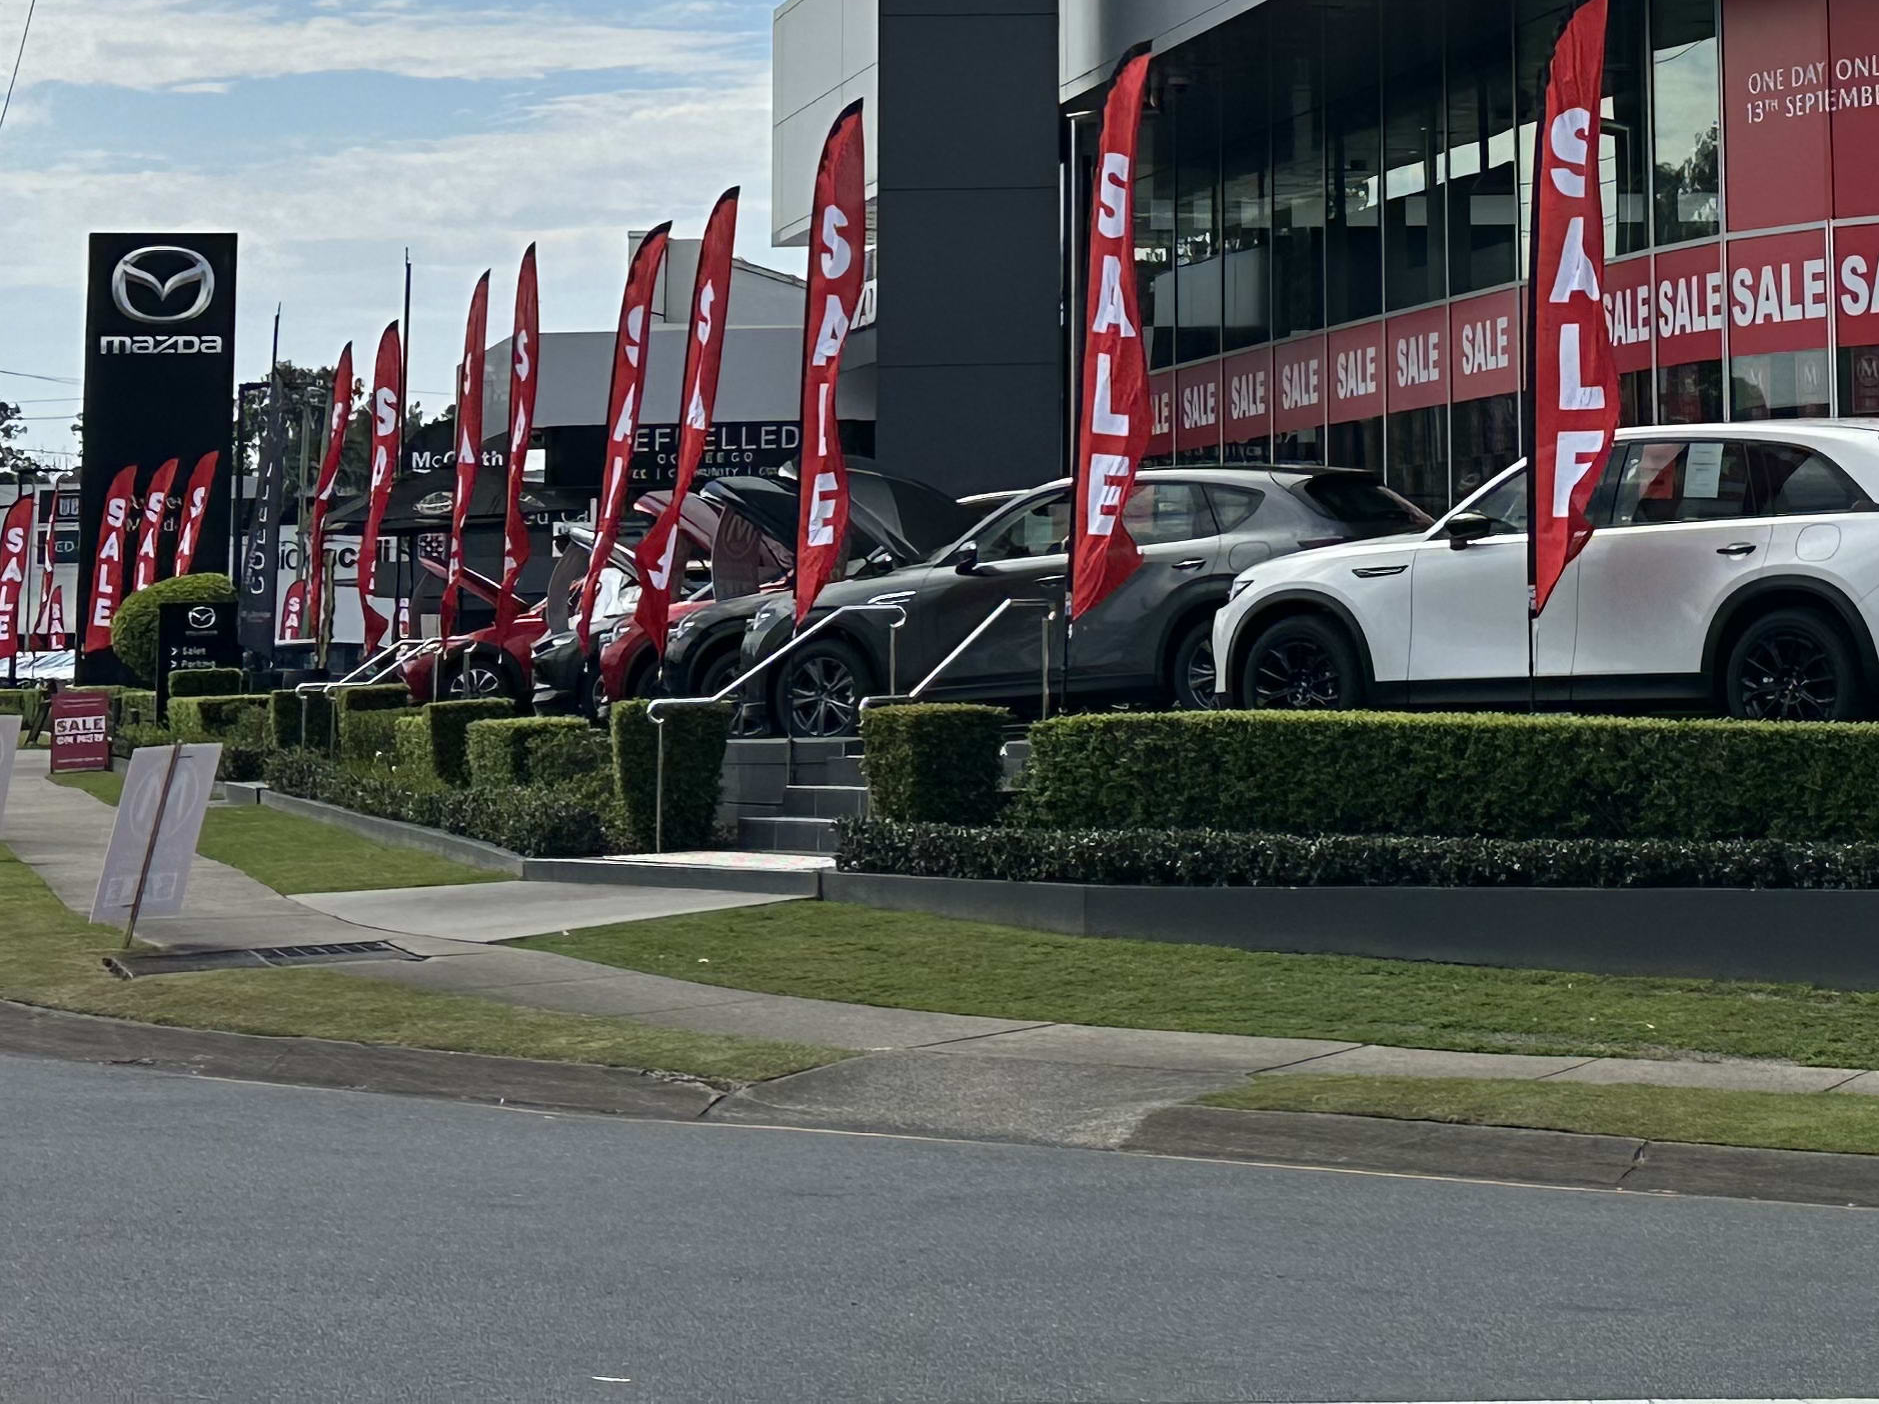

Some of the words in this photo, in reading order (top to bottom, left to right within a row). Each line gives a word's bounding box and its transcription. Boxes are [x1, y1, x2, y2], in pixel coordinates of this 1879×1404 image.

[1748, 68, 1785, 94] ONE
[1792, 61, 1825, 87] DAY
[1603, 285, 1650, 347] SALE
[1658, 272, 1722, 339] SALE
[1732, 258, 1827, 327] SALE
[1086, 152, 1136, 536] SALE
[1396, 331, 1440, 386] SALE
[1462, 316, 1509, 376] SALE
[1231, 371, 1265, 420] SALE
[1282, 358, 1319, 409] SALE
[1336, 346, 1377, 399] SALE
[1183, 382, 1216, 429] SALE
[634, 425, 799, 452] EFELLED
[93, 498, 126, 627] SALE
[137, 492, 165, 591] SAL
[57, 717, 104, 734] SALE
